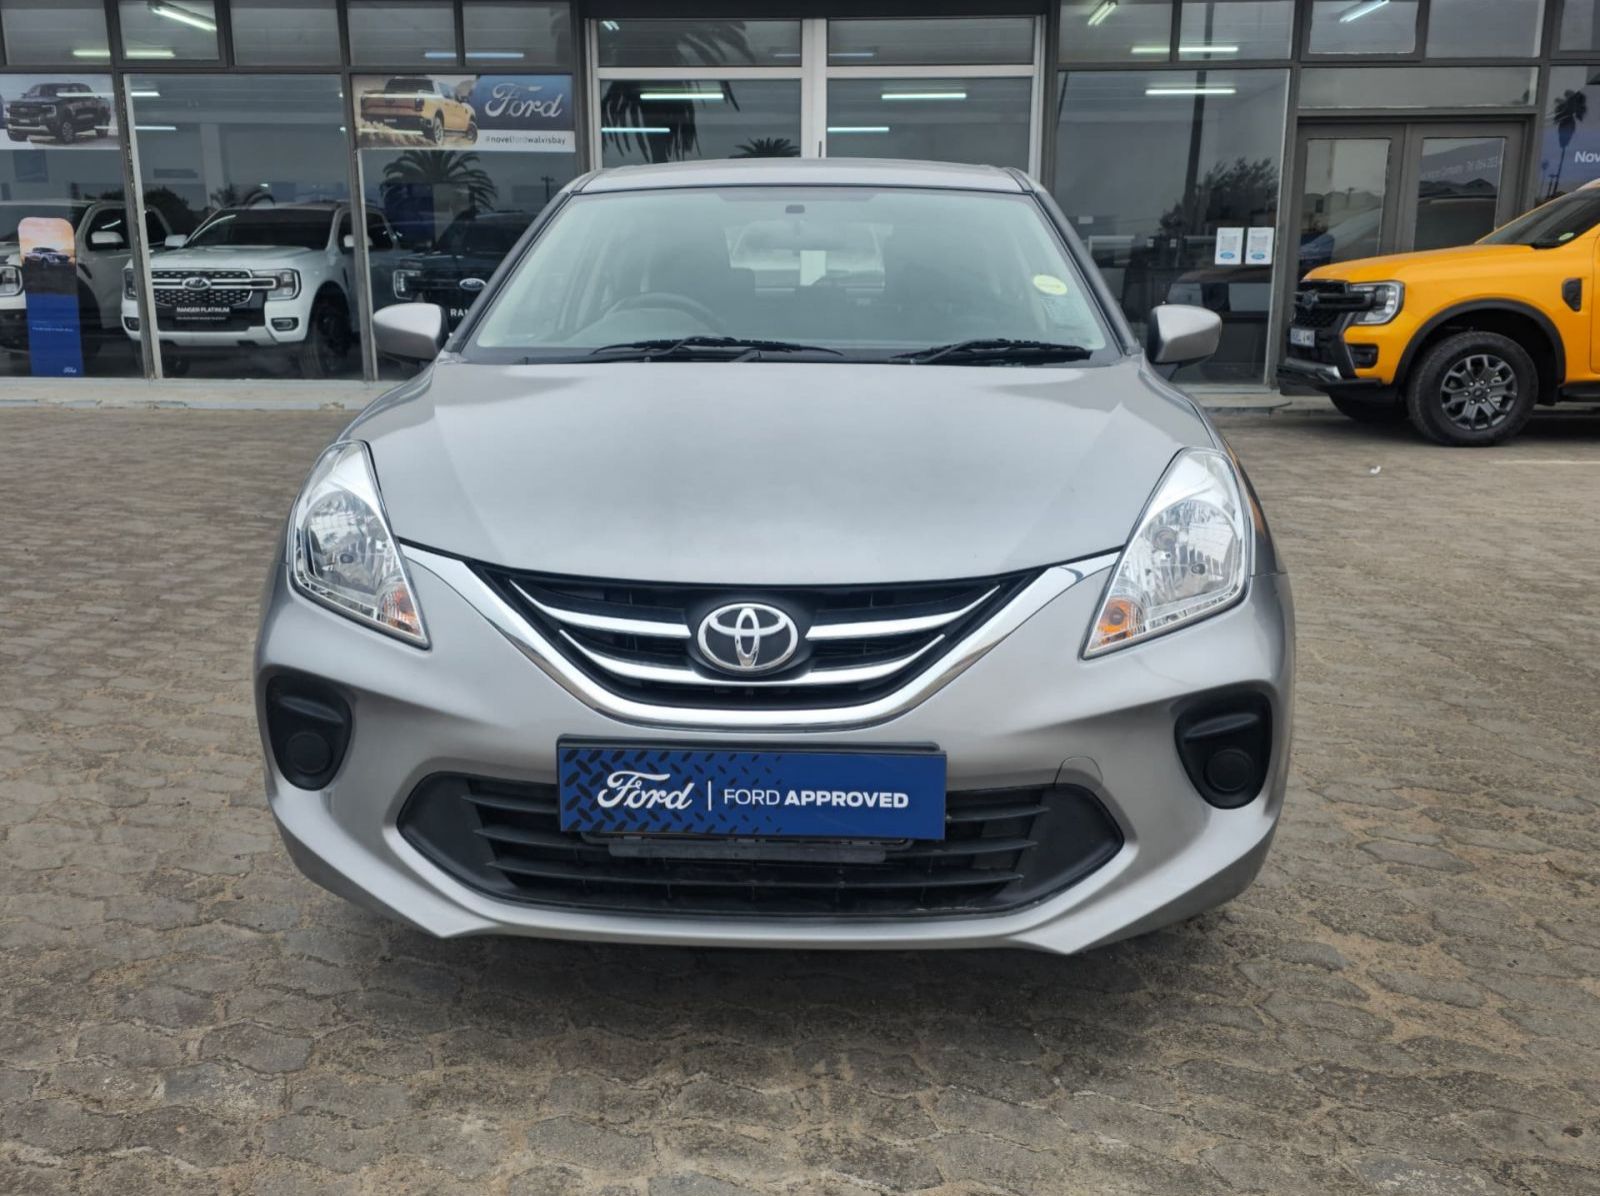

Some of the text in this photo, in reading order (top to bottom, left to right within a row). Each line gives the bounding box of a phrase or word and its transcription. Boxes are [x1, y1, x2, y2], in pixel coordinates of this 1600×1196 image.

[485, 82, 563, 118] Ford
[597, 770, 694, 810] Ford
[723, 787, 909, 809] FORD APPROVED
